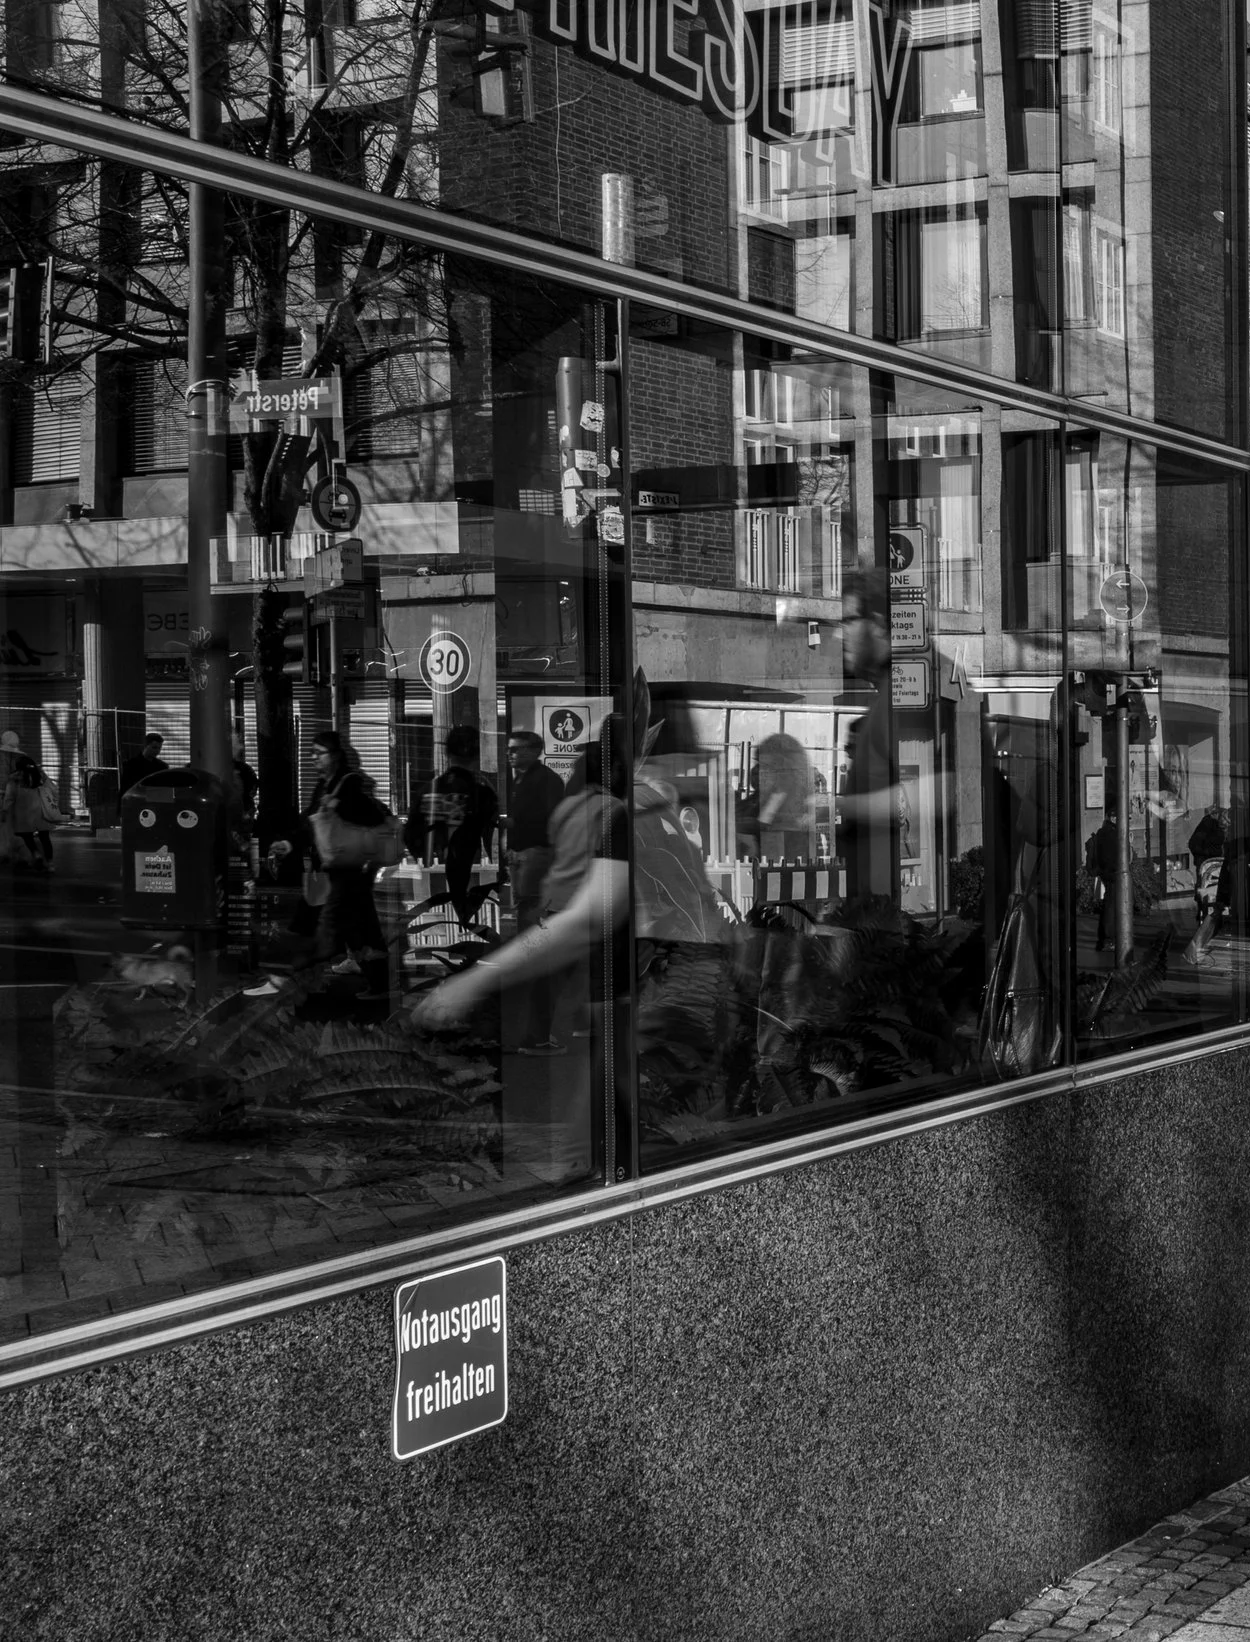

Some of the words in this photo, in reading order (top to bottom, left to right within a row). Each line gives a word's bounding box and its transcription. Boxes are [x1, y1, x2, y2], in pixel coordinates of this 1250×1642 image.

[890, 575, 910, 585] ONE
[890, 610, 916, 618] zeiten
[891, 622, 914, 630] ktags
[401, 1294, 500, 1353] Notausgang
[406, 1362, 494, 1421] freihalten
